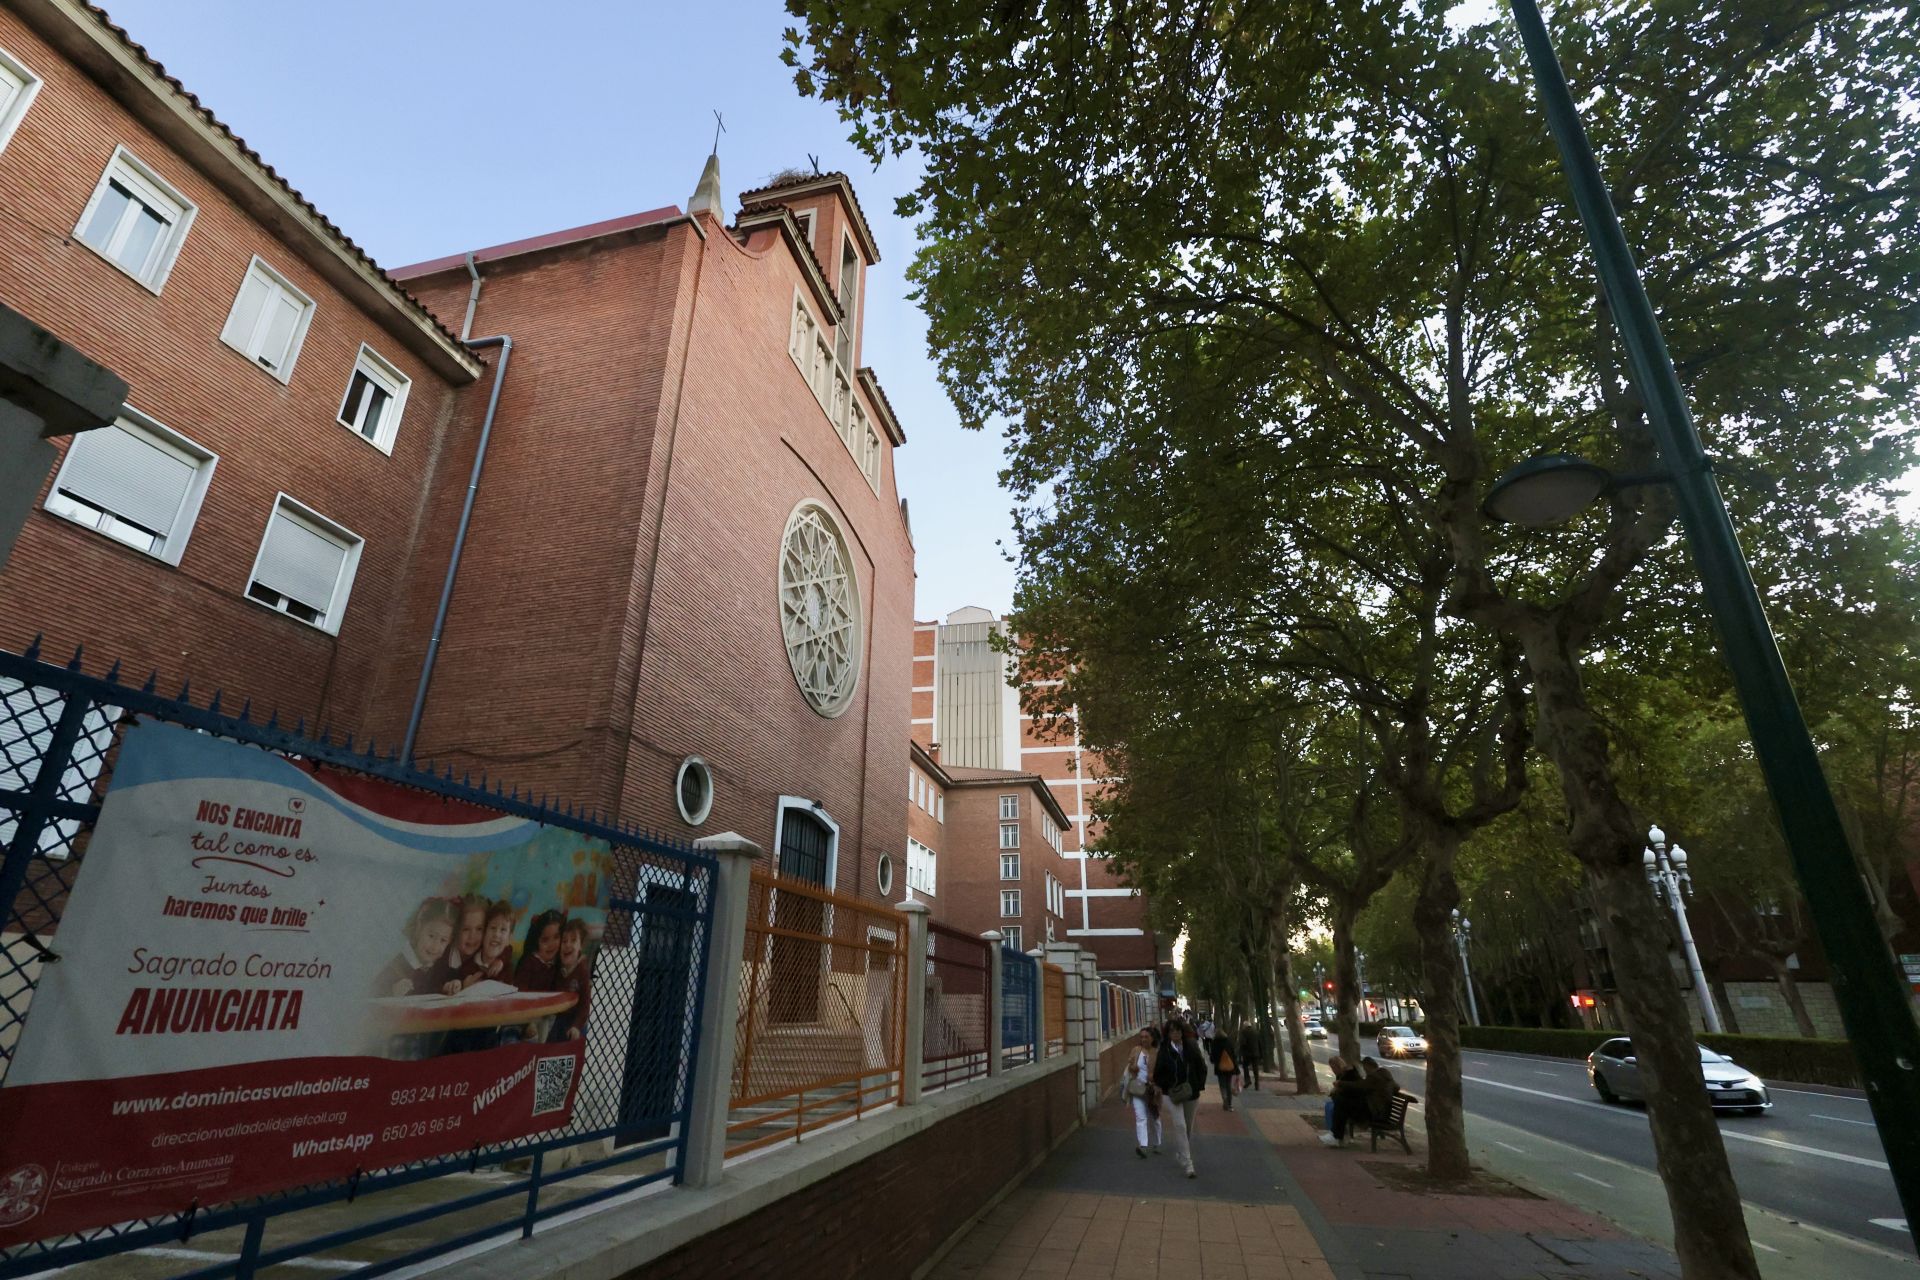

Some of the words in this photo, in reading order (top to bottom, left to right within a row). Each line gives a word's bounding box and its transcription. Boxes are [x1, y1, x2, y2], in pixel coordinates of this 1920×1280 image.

[196, 800, 231, 825] NOS
[233, 807, 302, 839] ENCANTA
[191, 831, 229, 853] tal
[234, 841, 291, 859] como
[201, 875, 272, 899] Juntos
[162, 895, 237, 921] haremos
[239, 906, 268, 925] que
[270, 907, 308, 927] brille
[128, 947, 237, 981] Sagrado
[244, 953, 332, 979] Corazón
[115, 987, 303, 1035] ANUNCIATA
[112, 1075, 370, 1116] www.dominicasvalladolid.es
[390, 1088, 416, 1106] 983
[418, 1086, 436, 1103] 24
[438, 1084, 451, 1100] 14
[454, 1081, 470, 1097] 02
[292, 1133, 374, 1159] WhatsApp
[382, 1123, 408, 1142] 650
[409, 1121, 426, 1138] 26
[429, 1117, 444, 1133] 96
[446, 1114, 462, 1131] 54
[54, 1171, 113, 1192] Sagrado
[116, 1153, 234, 1182] Corazón-Anunciata
